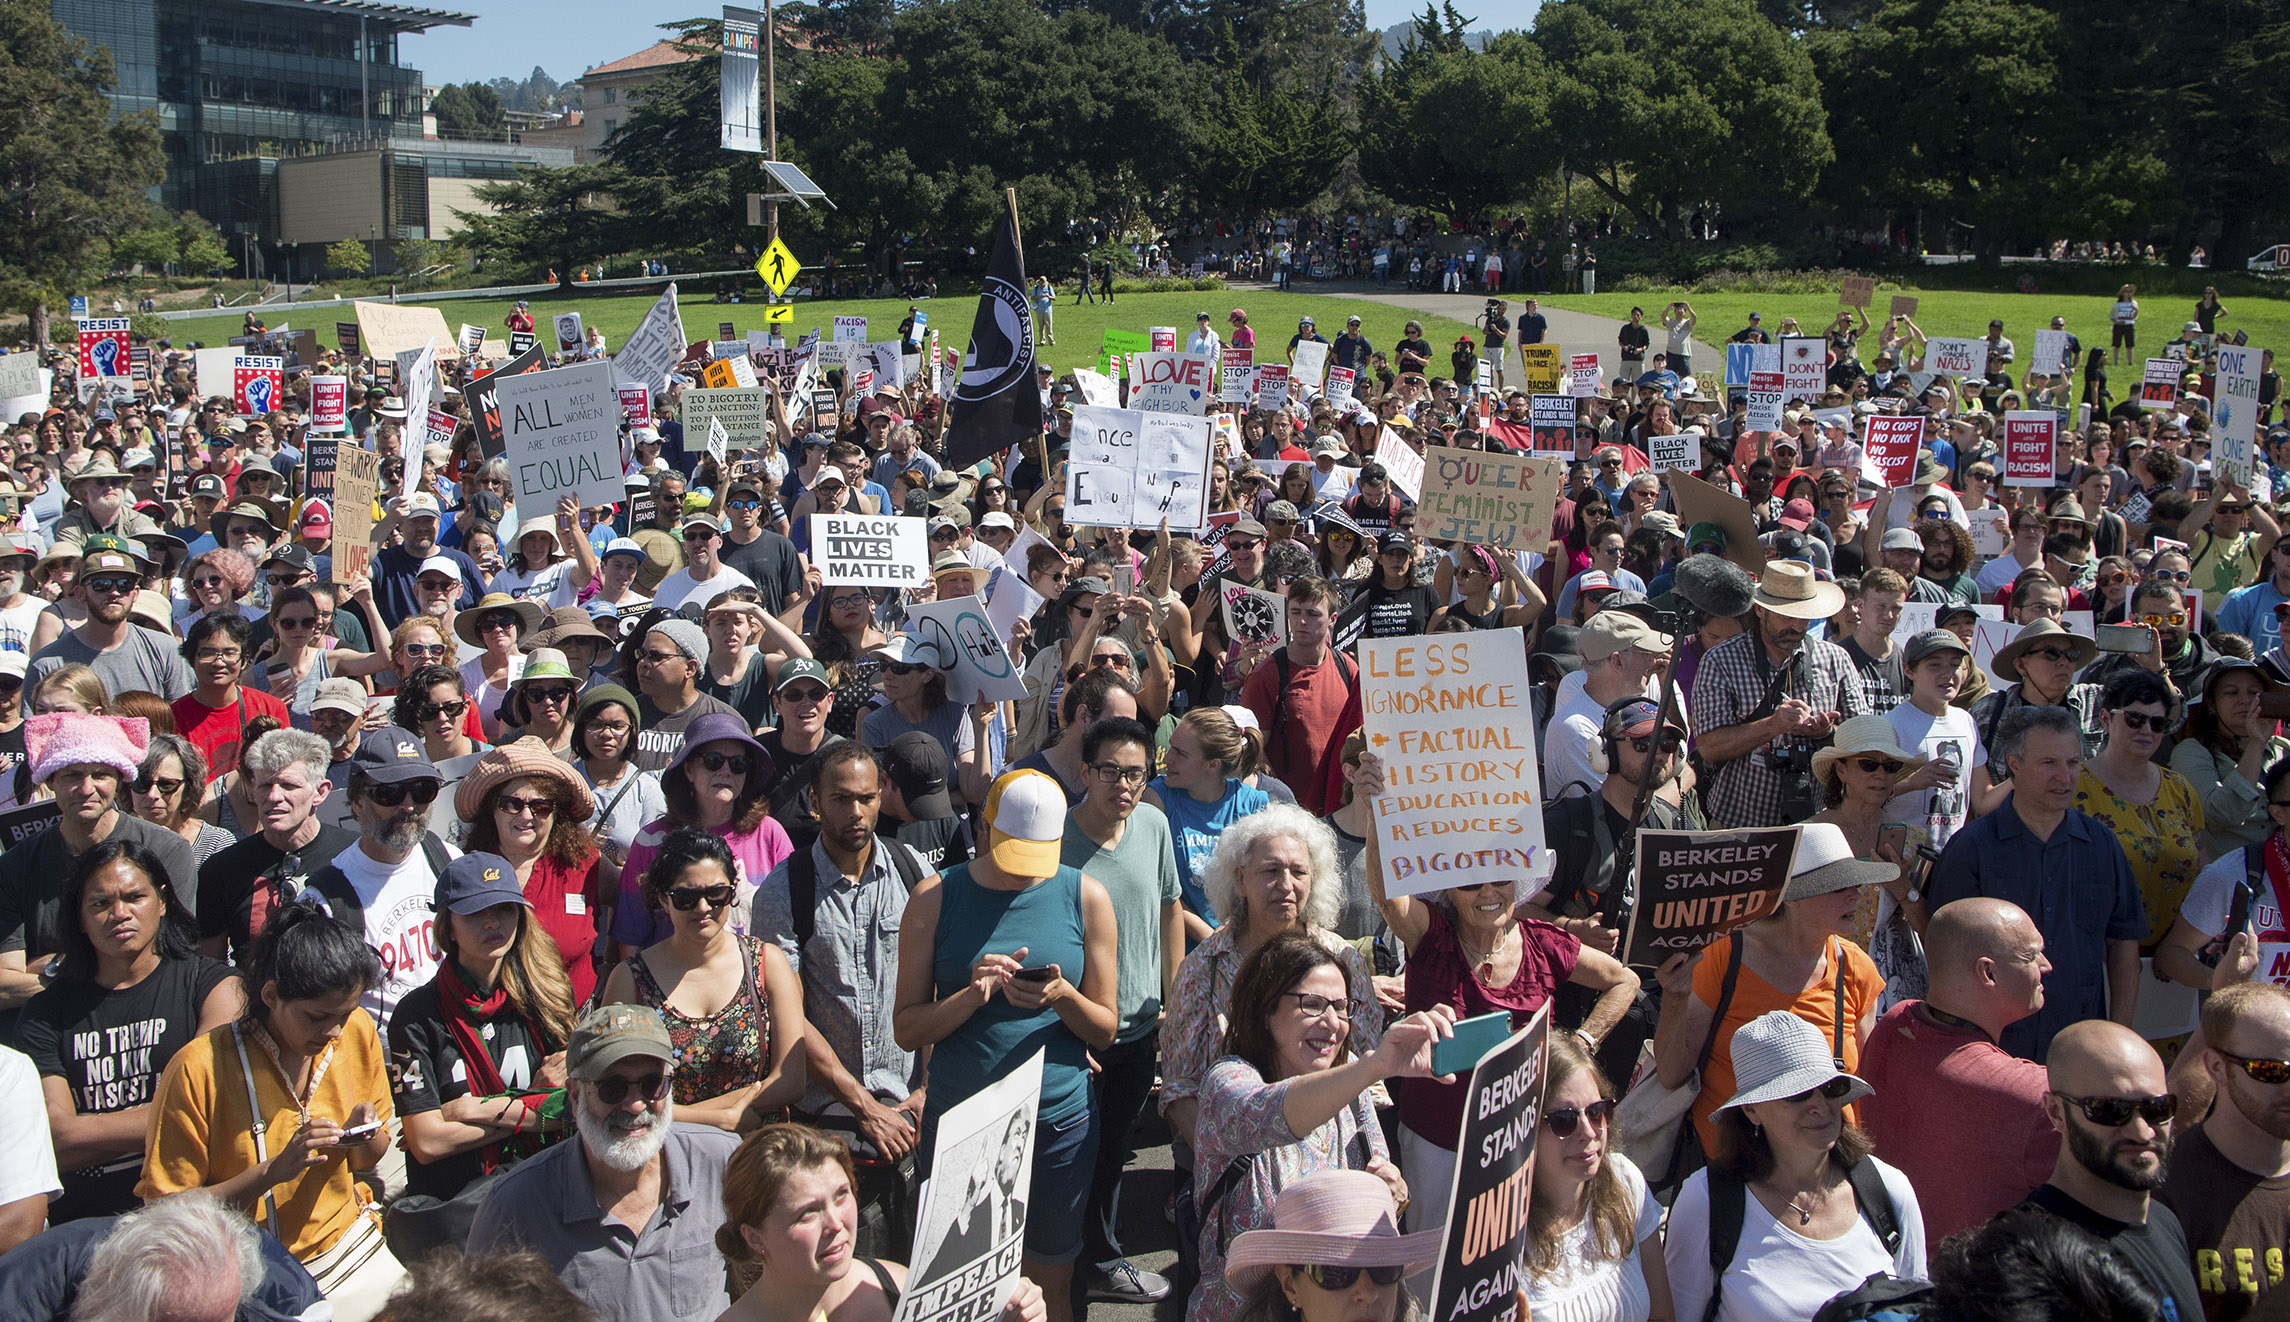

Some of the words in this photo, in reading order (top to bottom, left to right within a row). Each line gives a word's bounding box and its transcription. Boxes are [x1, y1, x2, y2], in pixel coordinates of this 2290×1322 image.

[723, 31, 758, 50] BAMPFA
[79, 319, 130, 331] RESIST
[834, 317, 867, 327] RACISM
[993, 284, 1031, 368] ANTIFASCIST
[846, 328, 856, 337] IS
[434, 347, 460, 356] LOVE
[876, 345, 898, 362] COUNTRY
[1525, 349, 1554, 358] TRUMP:
[2034, 344, 2062, 357] LIVES
[235, 356, 281, 368] RESIST
[1236, 359, 1250, 368] Right
[1534, 360, 1548, 368] FACE
[1582, 362, 1597, 370] Right
[1725, 344, 1754, 384] NO
[1788, 361, 1826, 373] DON'T
[2033, 357, 2061, 370] MATTER
[2147, 361, 2180, 372] BERKELEY
[2219, 351, 2246, 374] ONE
[8, 367, 37, 385] PLACE
[709, 364, 724, 377] NEVER
[1140, 357, 1205, 385] LOVE
[1223, 367, 1251, 377] STOP
[1331, 367, 1347, 375] Resist
[1573, 368, 1597, 378] STOP
[1696, 372, 1714, 380] SAY
[713, 376, 728, 388] AGAIN
[874, 376, 895, 390] CLEAN
[1341, 376, 1353, 384] Right
[1750, 374, 1774, 382] Resist
[1785, 378, 1821, 388] FIGHT
[317, 385, 342, 394] UNITE
[1151, 384, 1174, 395] THY
[1260, 380, 1286, 390] STOP
[1329, 380, 1351, 391] STOP
[1528, 380, 1557, 390] RACISM
[1750, 383, 1762, 391] the
[1764, 384, 1782, 392] Right
[2227, 376, 2258, 400] EARTH
[569, 392, 595, 407] MEN
[621, 391, 644, 399] UNITE
[688, 395, 705, 404] TO
[709, 393, 760, 403] BIGOTRY
[1749, 392, 1782, 403] STOP
[317, 399, 342, 408] FIGHT
[707, 404, 760, 412] SANCTION;
[1129, 398, 1189, 412] NEIGHBOR
[1535, 397, 1574, 410] BERKELEY
[1748, 403, 1771, 411] Racist
[313, 414, 344, 423] RACISM
[514, 399, 563, 434] ALL
[564, 408, 604, 424] WOMEN
[704, 414, 760, 422] PESECUTION
[1535, 410, 1558, 419] STANDS
[1559, 411, 1574, 420] WITH
[1748, 410, 1775, 418] Attacks
[435, 423, 453, 434] Right
[706, 422, 760, 431] AISTANCE
[1873, 421, 1889, 431] NO
[1891, 421, 1919, 432] COPS
[2012, 423, 2047, 433] UNITE
[527, 439, 546, 452] ARE
[551, 429, 599, 448] CREATED
[1653, 439, 1689, 449] BLACK
[1871, 433, 1889, 443] NO
[1889, 434, 1912, 444] KKK
[1870, 445, 1887, 455] NO
[2012, 442, 2047, 452] FIGHT
[2222, 436, 2245, 460] ONE
[1654, 450, 1685, 460] LIVES
[1869, 456, 1908, 466] FASCIST
[2018, 455, 2041, 463] against
[339, 452, 351, 472] THE
[350, 450, 378, 483] WORK
[1655, 459, 1696, 470] MATTER
[2008, 462, 2051, 472] RACISM
[519, 451, 616, 496] EQUAL
[2215, 456, 2250, 486] PEOPLE
[336, 477, 372, 508] CONTINUES
[633, 510, 656, 522] STANDS
[827, 520, 900, 536] BLACK
[1440, 517, 1517, 547] JEW
[828, 541, 892, 558] LIVES
[343, 542, 368, 578] LOVE
[829, 563, 915, 579] MATTER
[527, 586, 540, 595] can
[1223, 586, 1249, 606] LOVE
[1336, 626, 1350, 641] END
[1369, 642, 1471, 679] LESS
[1365, 683, 1518, 714] IGNORANCE
[1398, 726, 1526, 754] FACTUAL
[396, 740, 416, 753] Cal
[1378, 790, 1532, 817] EDUCATION
[1392, 817, 1524, 842] REDUCES
[1657, 843, 1778, 867] BERKELEY
[1391, 844, 1537, 881] BIGOTRY
[483, 867, 500, 882] Cal
[1664, 867, 1764, 890] STANDS
[1652, 889, 1767, 929] UNITED
[73, 1030, 100, 1060] NO
[106, 1018, 167, 1055] TRUMP
[86, 1055, 115, 1086] NO
[121, 1047, 152, 1078] KKK
[1478, 1040, 1545, 1121] BERKELEY
[1480, 1095, 1538, 1169] STANDS
[901, 1232, 1024, 1322] IMPEACH
